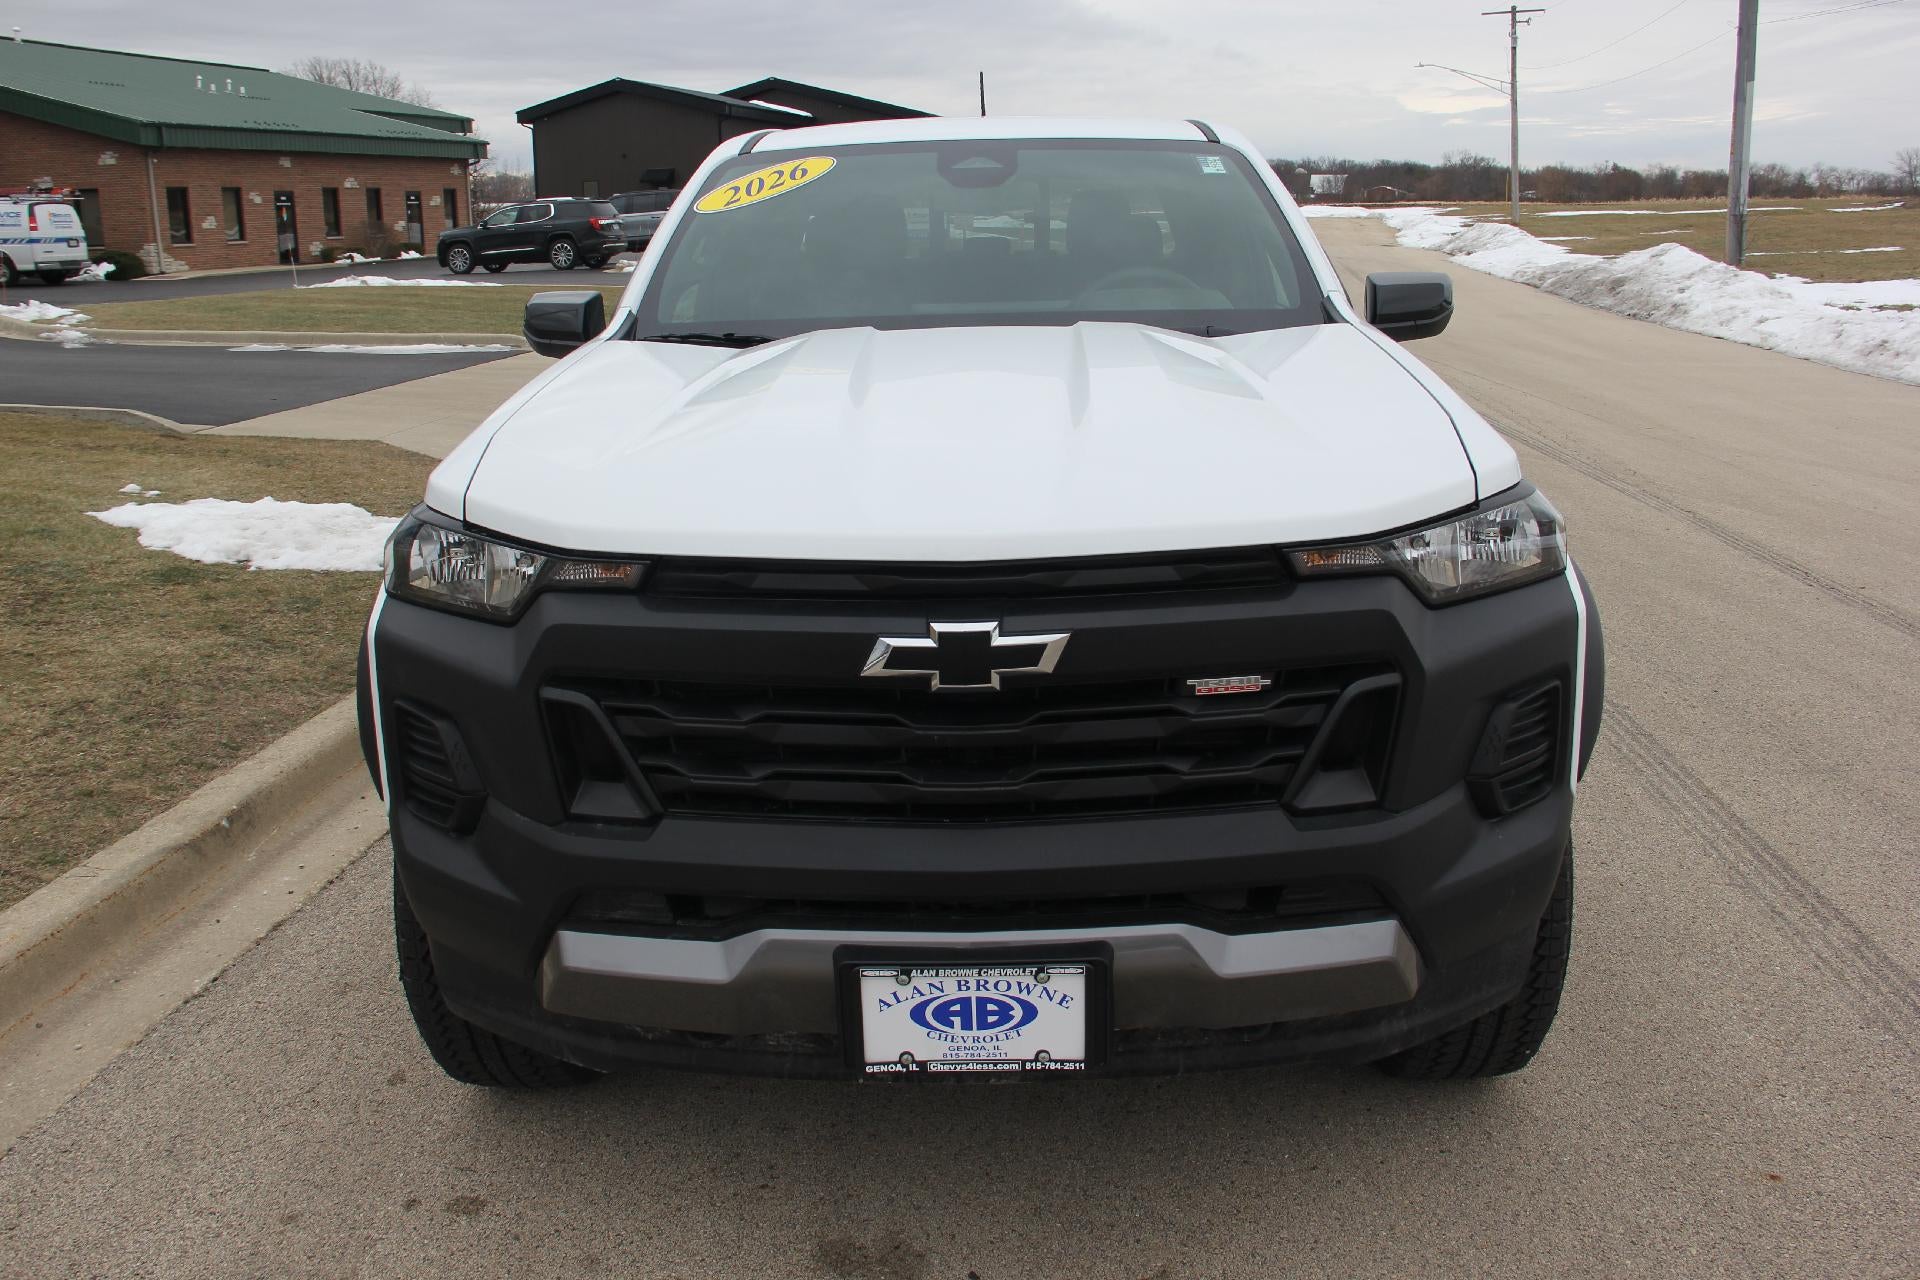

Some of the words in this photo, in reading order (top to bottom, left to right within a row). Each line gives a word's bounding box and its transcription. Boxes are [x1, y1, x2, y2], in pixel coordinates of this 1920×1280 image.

[723, 160, 809, 207] 2026
[910, 969, 936, 977] ALAN
[939, 968, 979, 977] BROWNE
[981, 967, 1038, 977] CHEVROLET
[879, 980, 945, 1013] ALAN
[956, 979, 1074, 1010] BROWNE
[931, 996, 1016, 1032] AB
[926, 1028, 1023, 1045] CHEVROLET
[942, 1051, 1008, 1059] 815-784-2511
[865, 1064, 907, 1073] GENOA,
[909, 1063, 920, 1071] IL
[929, 1061, 1019, 1072] Chevys4less.com
[1025, 1062, 1086, 1070] 815-784-2511
